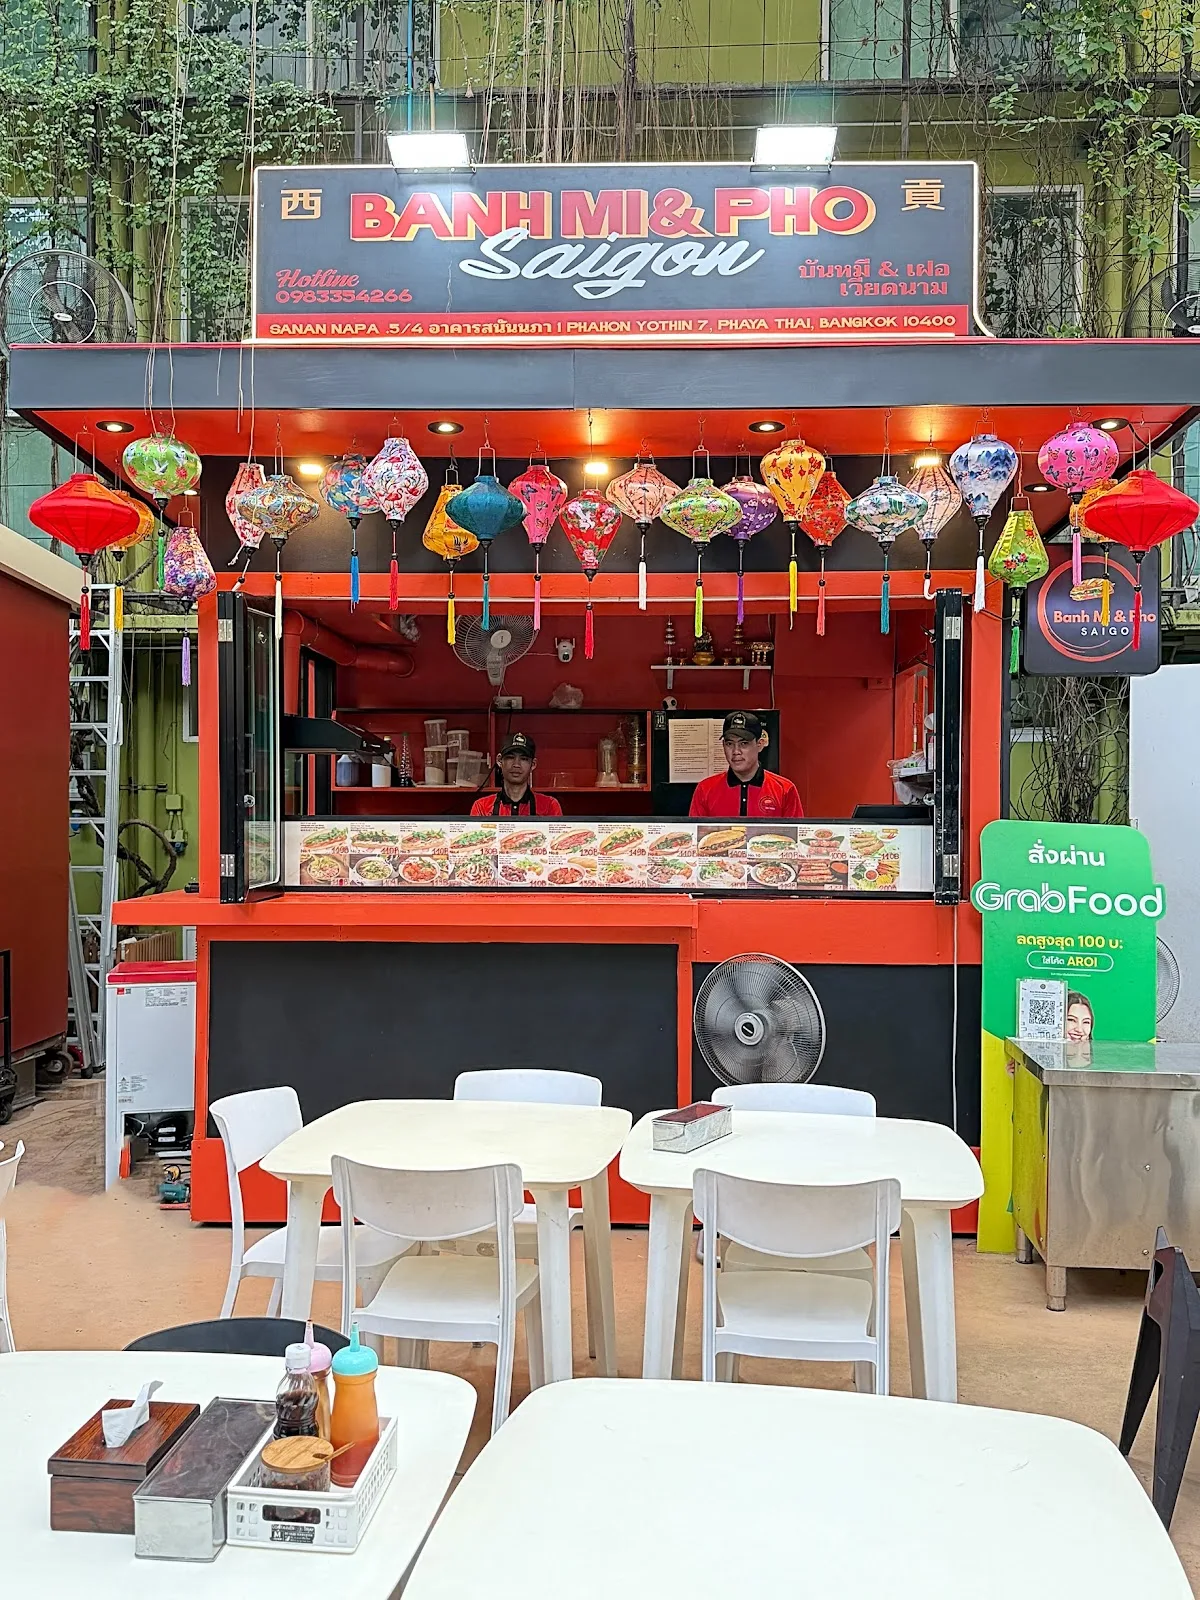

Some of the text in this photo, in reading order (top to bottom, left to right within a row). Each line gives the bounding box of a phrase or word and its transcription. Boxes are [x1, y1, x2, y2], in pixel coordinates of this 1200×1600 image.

[280, 189, 323, 220] 西
[350, 191, 552, 241] BANH
[715, 186, 877, 236] PHO
[459, 227, 765, 300] Saigon
[878, 261, 899, 277] &
[906, 260, 950, 277] เฝอ
[276, 269, 360, 288] Hotline
[840, 277, 948, 297] เวียดนาม
[276, 289, 413, 304] 0983354266
[269, 323, 327, 335] SANAN
[331, 323, 379, 335] NAPA
[566, 320, 631, 333] PHAHON
[636, 319, 693, 332] YOTHIN
[697, 319, 713, 333] 7,
[717, 318, 769, 330] PHAYA
[774, 318, 815, 331] THAI,
[819, 316, 898, 329] BANGKOK
[903, 315, 956, 328] 10400
[1053, 610, 1090, 623] Banh
[1113, 611, 1127, 623] &
[1080, 626, 1130, 636] SAIGO
[1028, 838, 1106, 867] สั่งผ่าน
[975, 882, 1163, 918] GrabFood
[1016, 935, 1075, 950] ลดสูงสุด
[1077, 935, 1106, 949] 100
[1066, 956, 1098, 968] AROI
